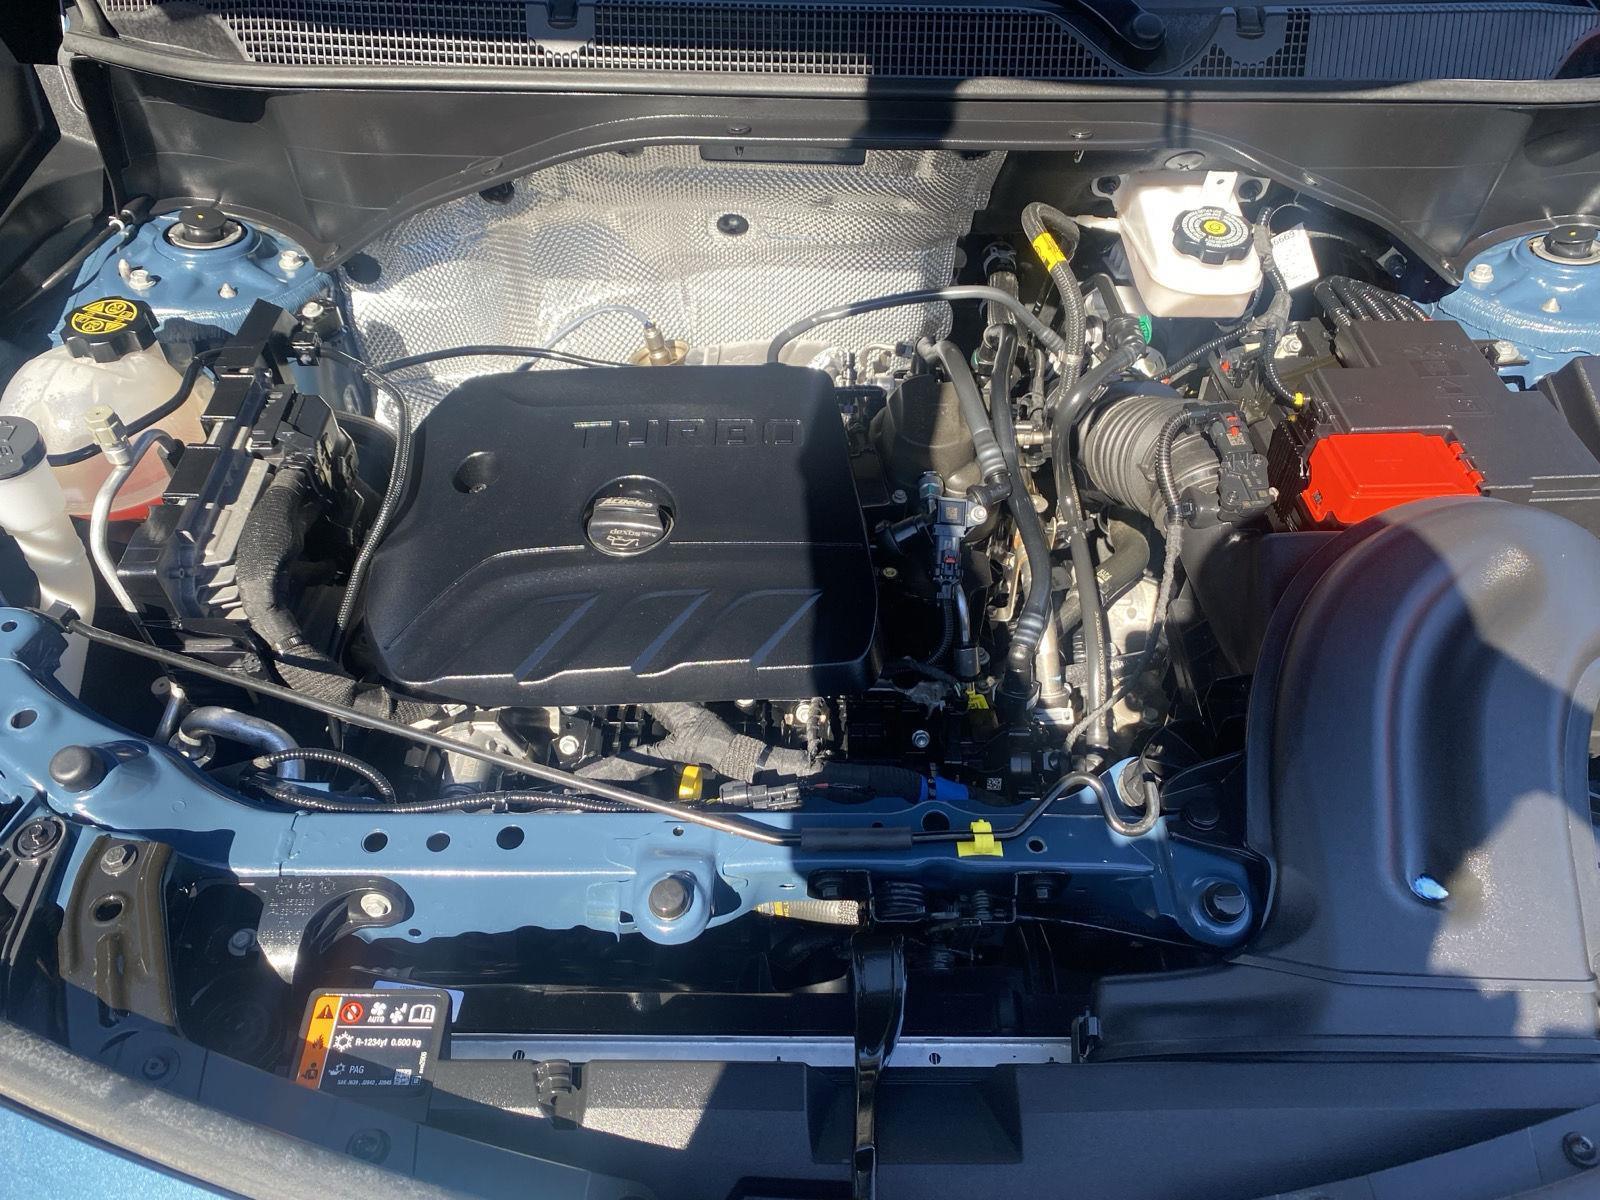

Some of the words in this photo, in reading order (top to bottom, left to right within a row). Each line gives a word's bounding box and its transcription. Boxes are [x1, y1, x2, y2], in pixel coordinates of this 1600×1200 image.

[573, 418, 804, 449] TURBO
[367, 1015, 385, 1023] AUTO
[355, 1037, 388, 1048] R-1234yf
[390, 1038, 411, 1047] 0.600
[411, 1038, 422, 1048] kg
[349, 1065, 365, 1074] PAG
